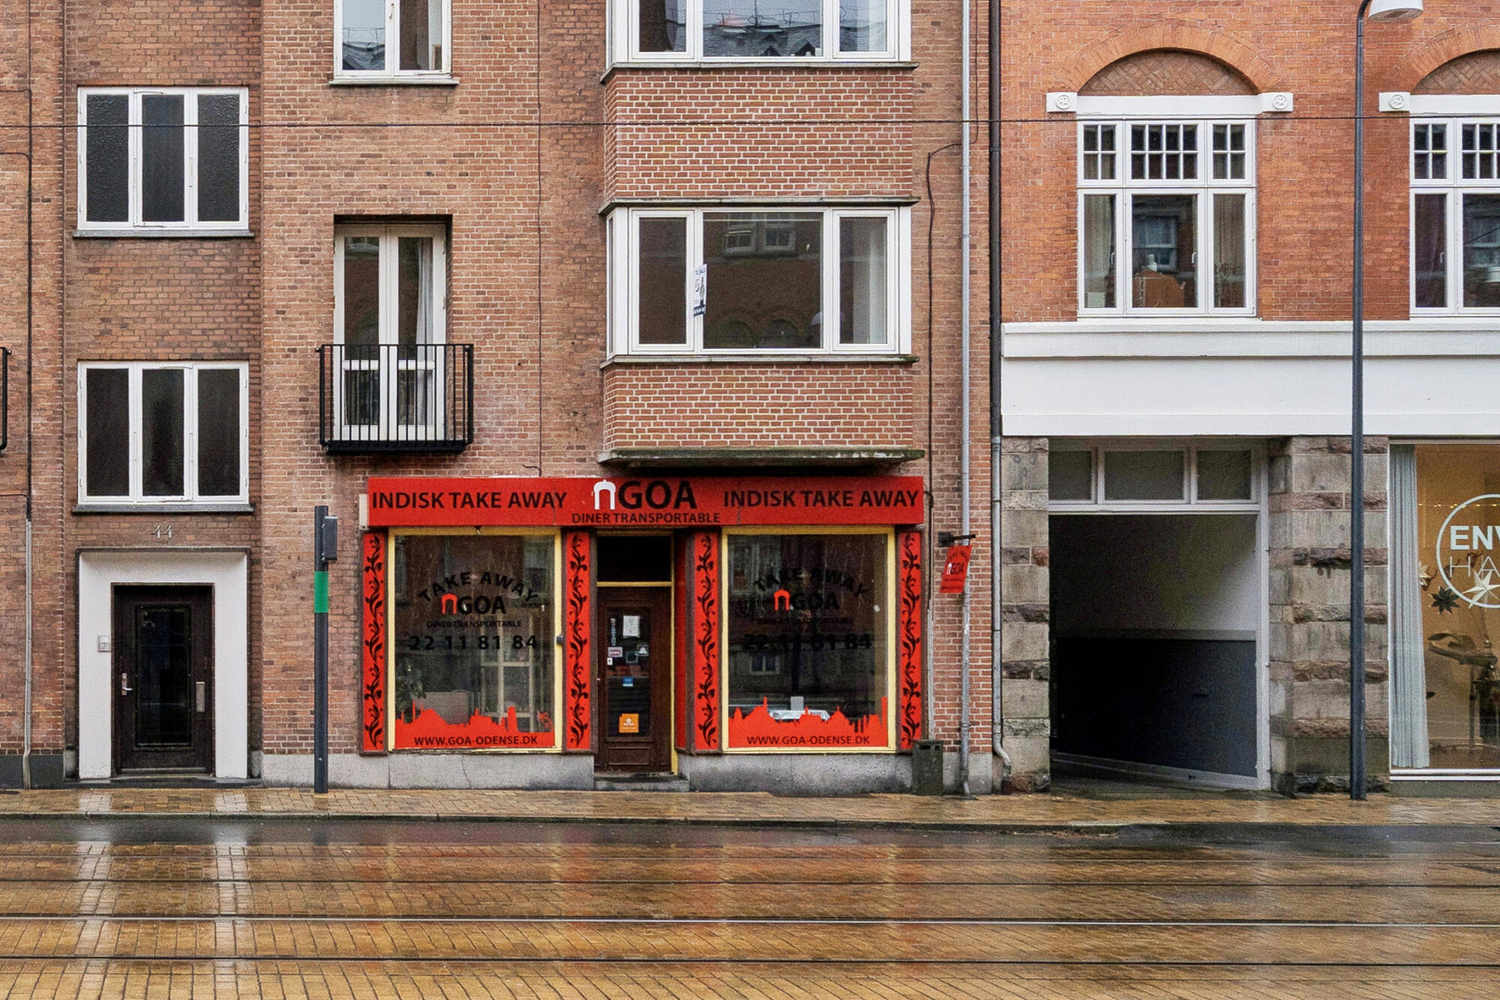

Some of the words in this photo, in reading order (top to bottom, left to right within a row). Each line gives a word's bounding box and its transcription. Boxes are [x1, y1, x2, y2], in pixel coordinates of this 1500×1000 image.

[372, 491, 445, 509] INDISK
[449, 491, 502, 509] TAKE
[507, 491, 568, 509] AWAY
[617, 480, 698, 510] GOA
[724, 490, 796, 507] INDISK
[801, 490, 853, 507] TAKE
[859, 490, 920, 507] AWAY
[572, 513, 611, 523] DINER
[614, 513, 720, 523] TRANSPORTABLE
[1450, 525, 1500, 550] EN
[418, 571, 472, 602] TAKE
[480, 571, 539, 602] AWAY
[457, 595, 507, 614] GOA
[409, 635, 435, 650] 22
[444, 635, 467, 650] 11
[478, 635, 501, 650] 81
[512, 634, 537, 649] 84
[414, 735, 538, 746] WWW.GOA-ODENSE.DK
[747, 735, 870, 745] WWW.GOA-ODENSE.DK
